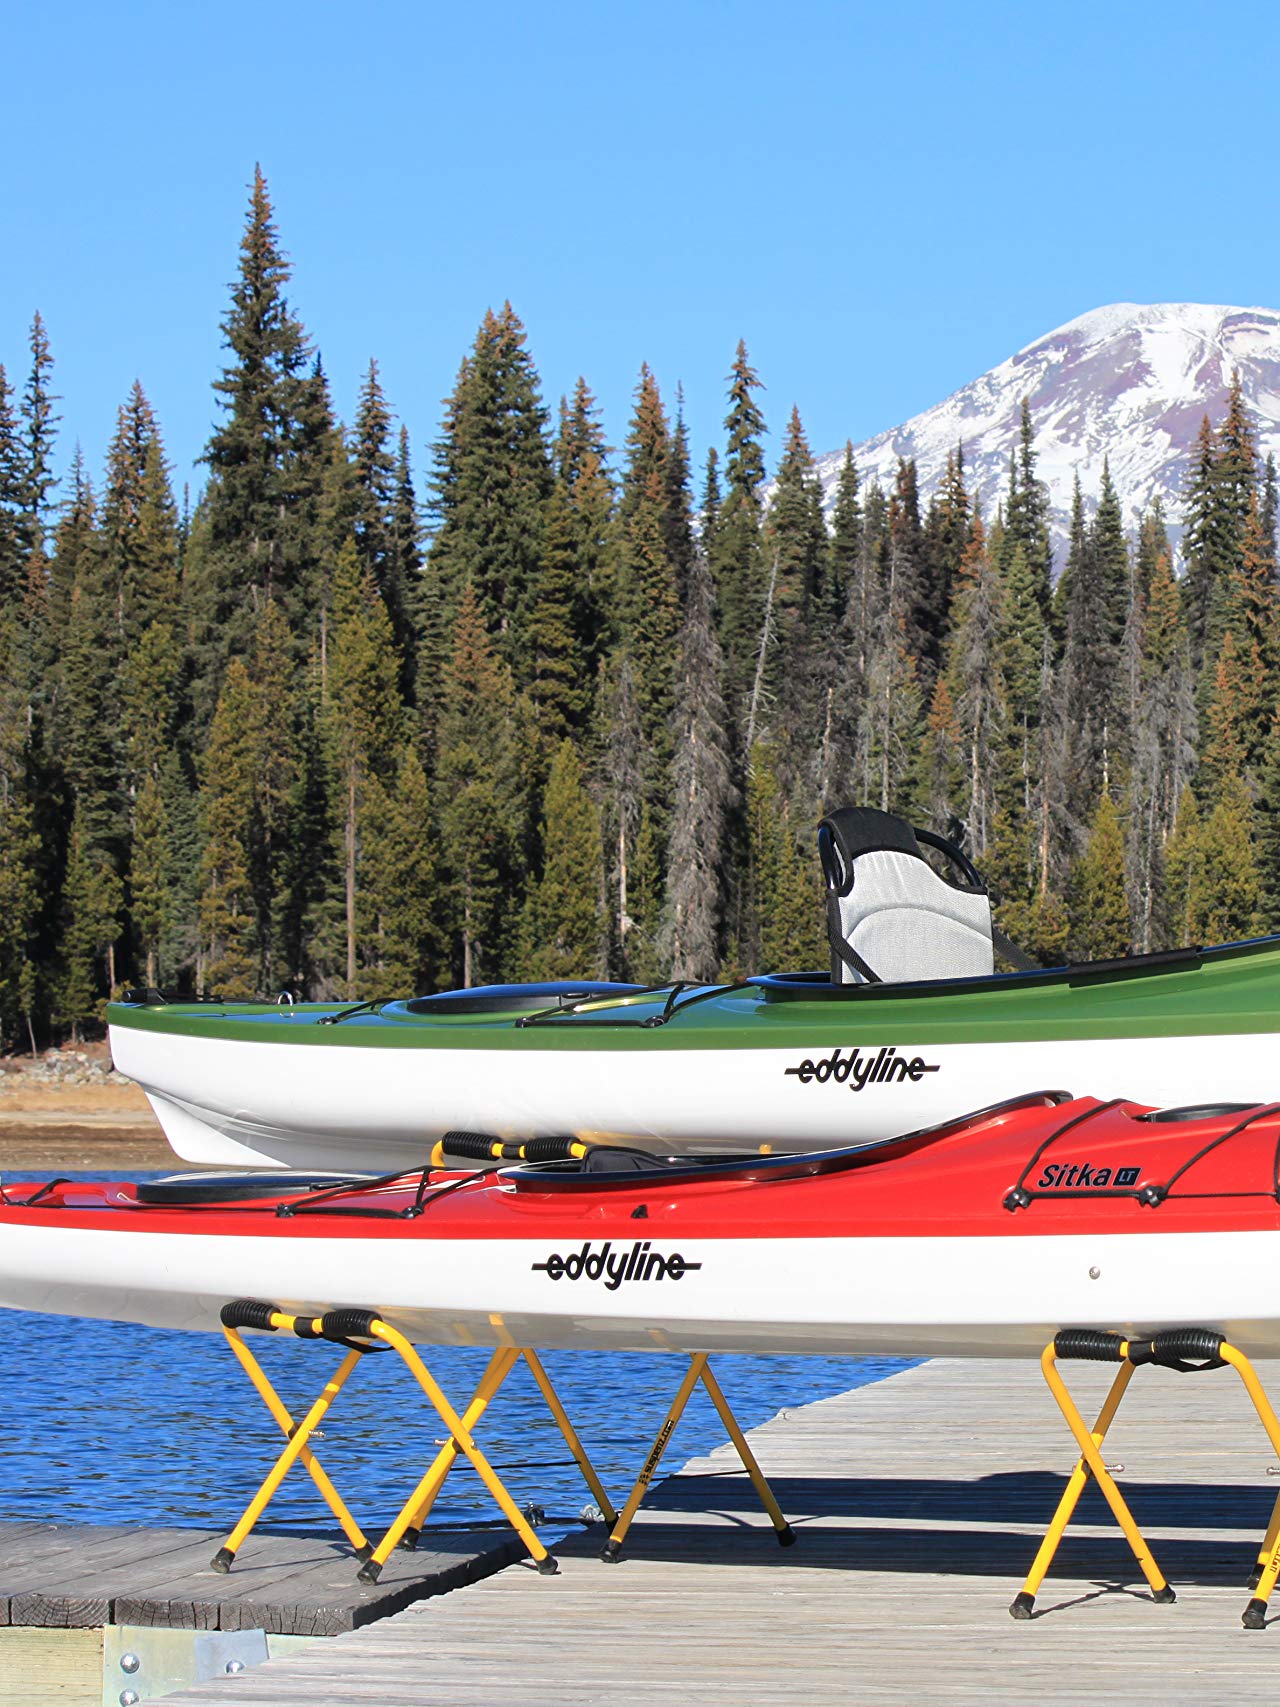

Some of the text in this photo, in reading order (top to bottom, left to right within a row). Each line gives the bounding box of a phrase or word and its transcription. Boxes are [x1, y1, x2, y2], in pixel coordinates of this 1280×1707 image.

[784, 1047, 940, 1092] eddyline
[1038, 1163, 1112, 1189] Sitka
[531, 1241, 702, 1291] eddyline
